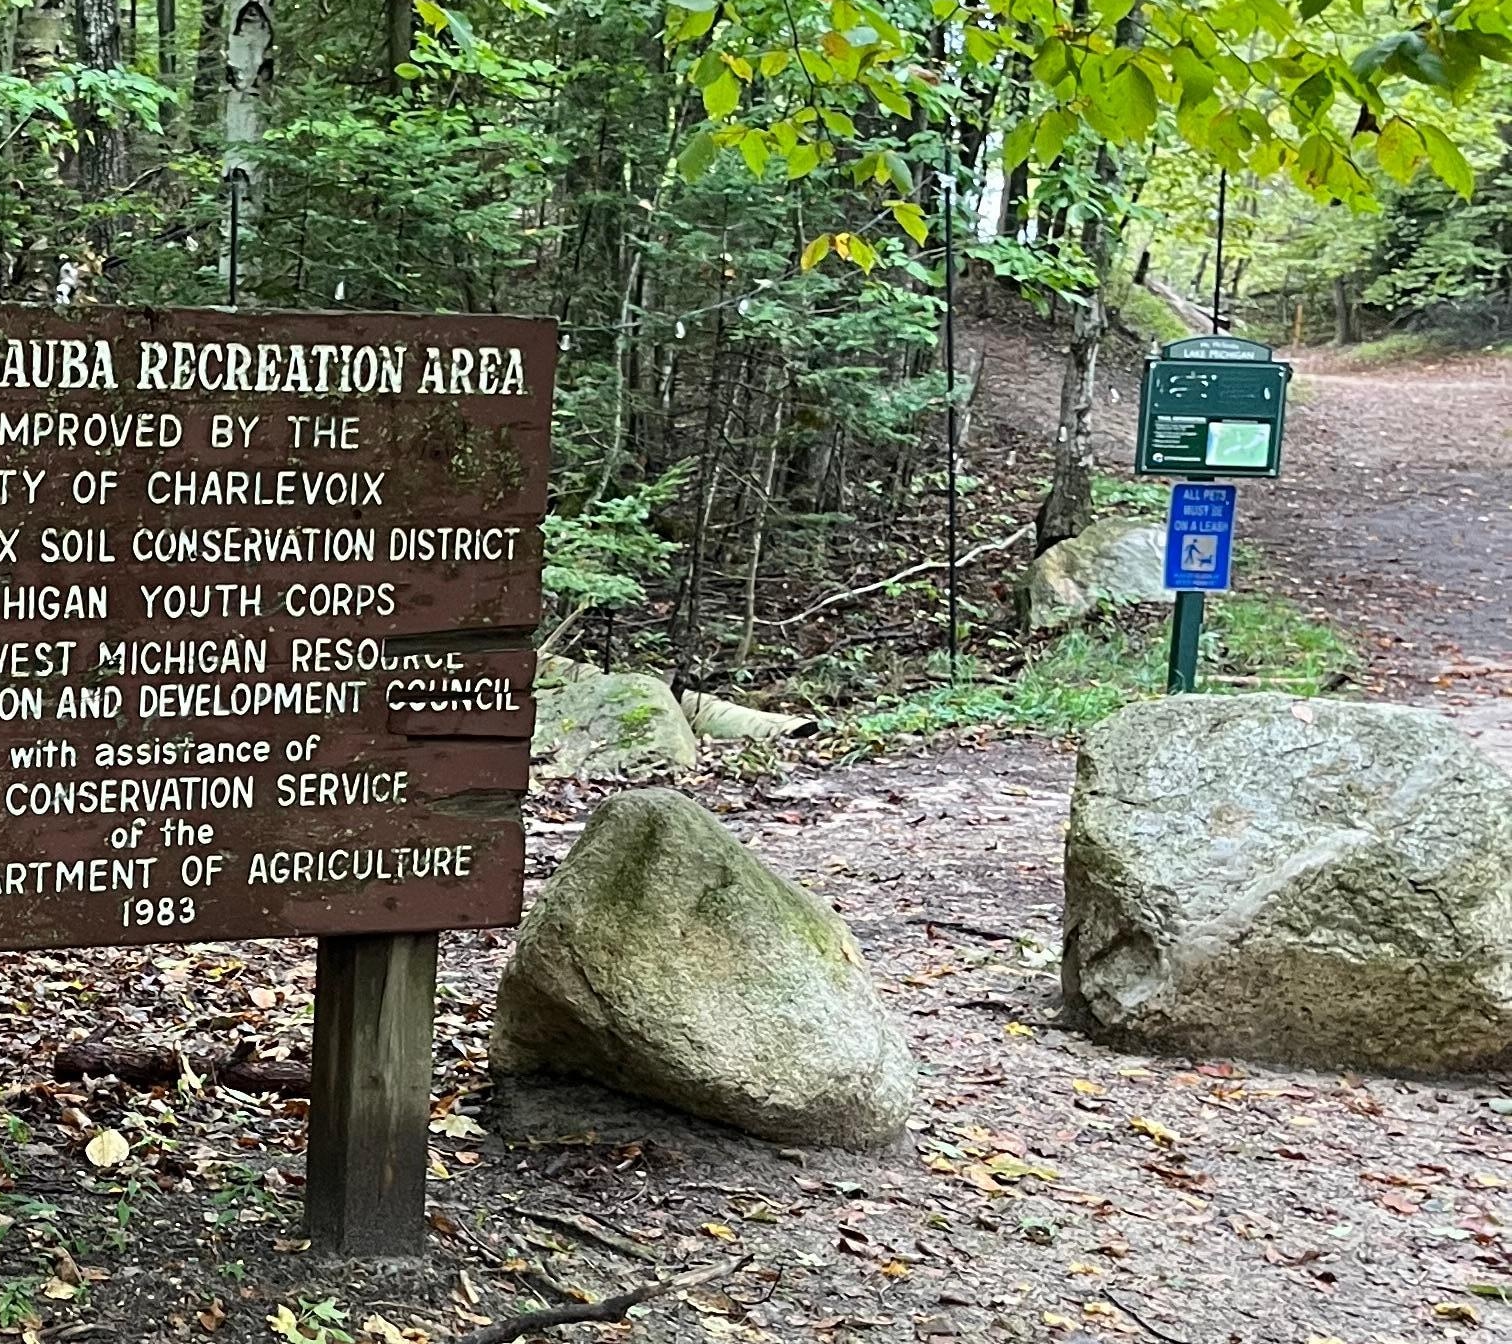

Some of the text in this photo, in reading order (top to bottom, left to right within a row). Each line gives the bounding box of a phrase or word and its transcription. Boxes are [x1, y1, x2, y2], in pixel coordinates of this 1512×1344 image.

[135, 340, 406, 395] RECREATION
[417, 344, 527, 396] AREA
[212, 415, 259, 448] BY
[288, 416, 360, 449] THE
[73, 471, 118, 504] OF
[147, 472, 384, 505] CHARLEVOIX
[1183, 489, 1227, 502] ALL PETS
[1173, 520, 1229, 533] ON A LEASH
[1183, 505, 1209, 517] MUST
[41, 529, 116, 563] SOIL
[132, 528, 375, 562] CONSERVATION
[389, 528, 519, 561] DISTRICT
[140, 584, 263, 619] YOUTH
[285, 584, 396, 616] CORPS
[100, 639, 267, 675] MICHIGAN
[57, 684, 122, 719] AND
[139, 682, 365, 717] DEVELOPMENT
[10, 735, 321, 768] with assistance of
[5, 778, 254, 814] CONSERVATION
[277, 773, 409, 807] SERVICE
[111, 817, 213, 850] of the
[181, 855, 223, 887] OF
[248, 846, 471, 885] AGRICULTURE
[122, 898, 195, 928] 1983
